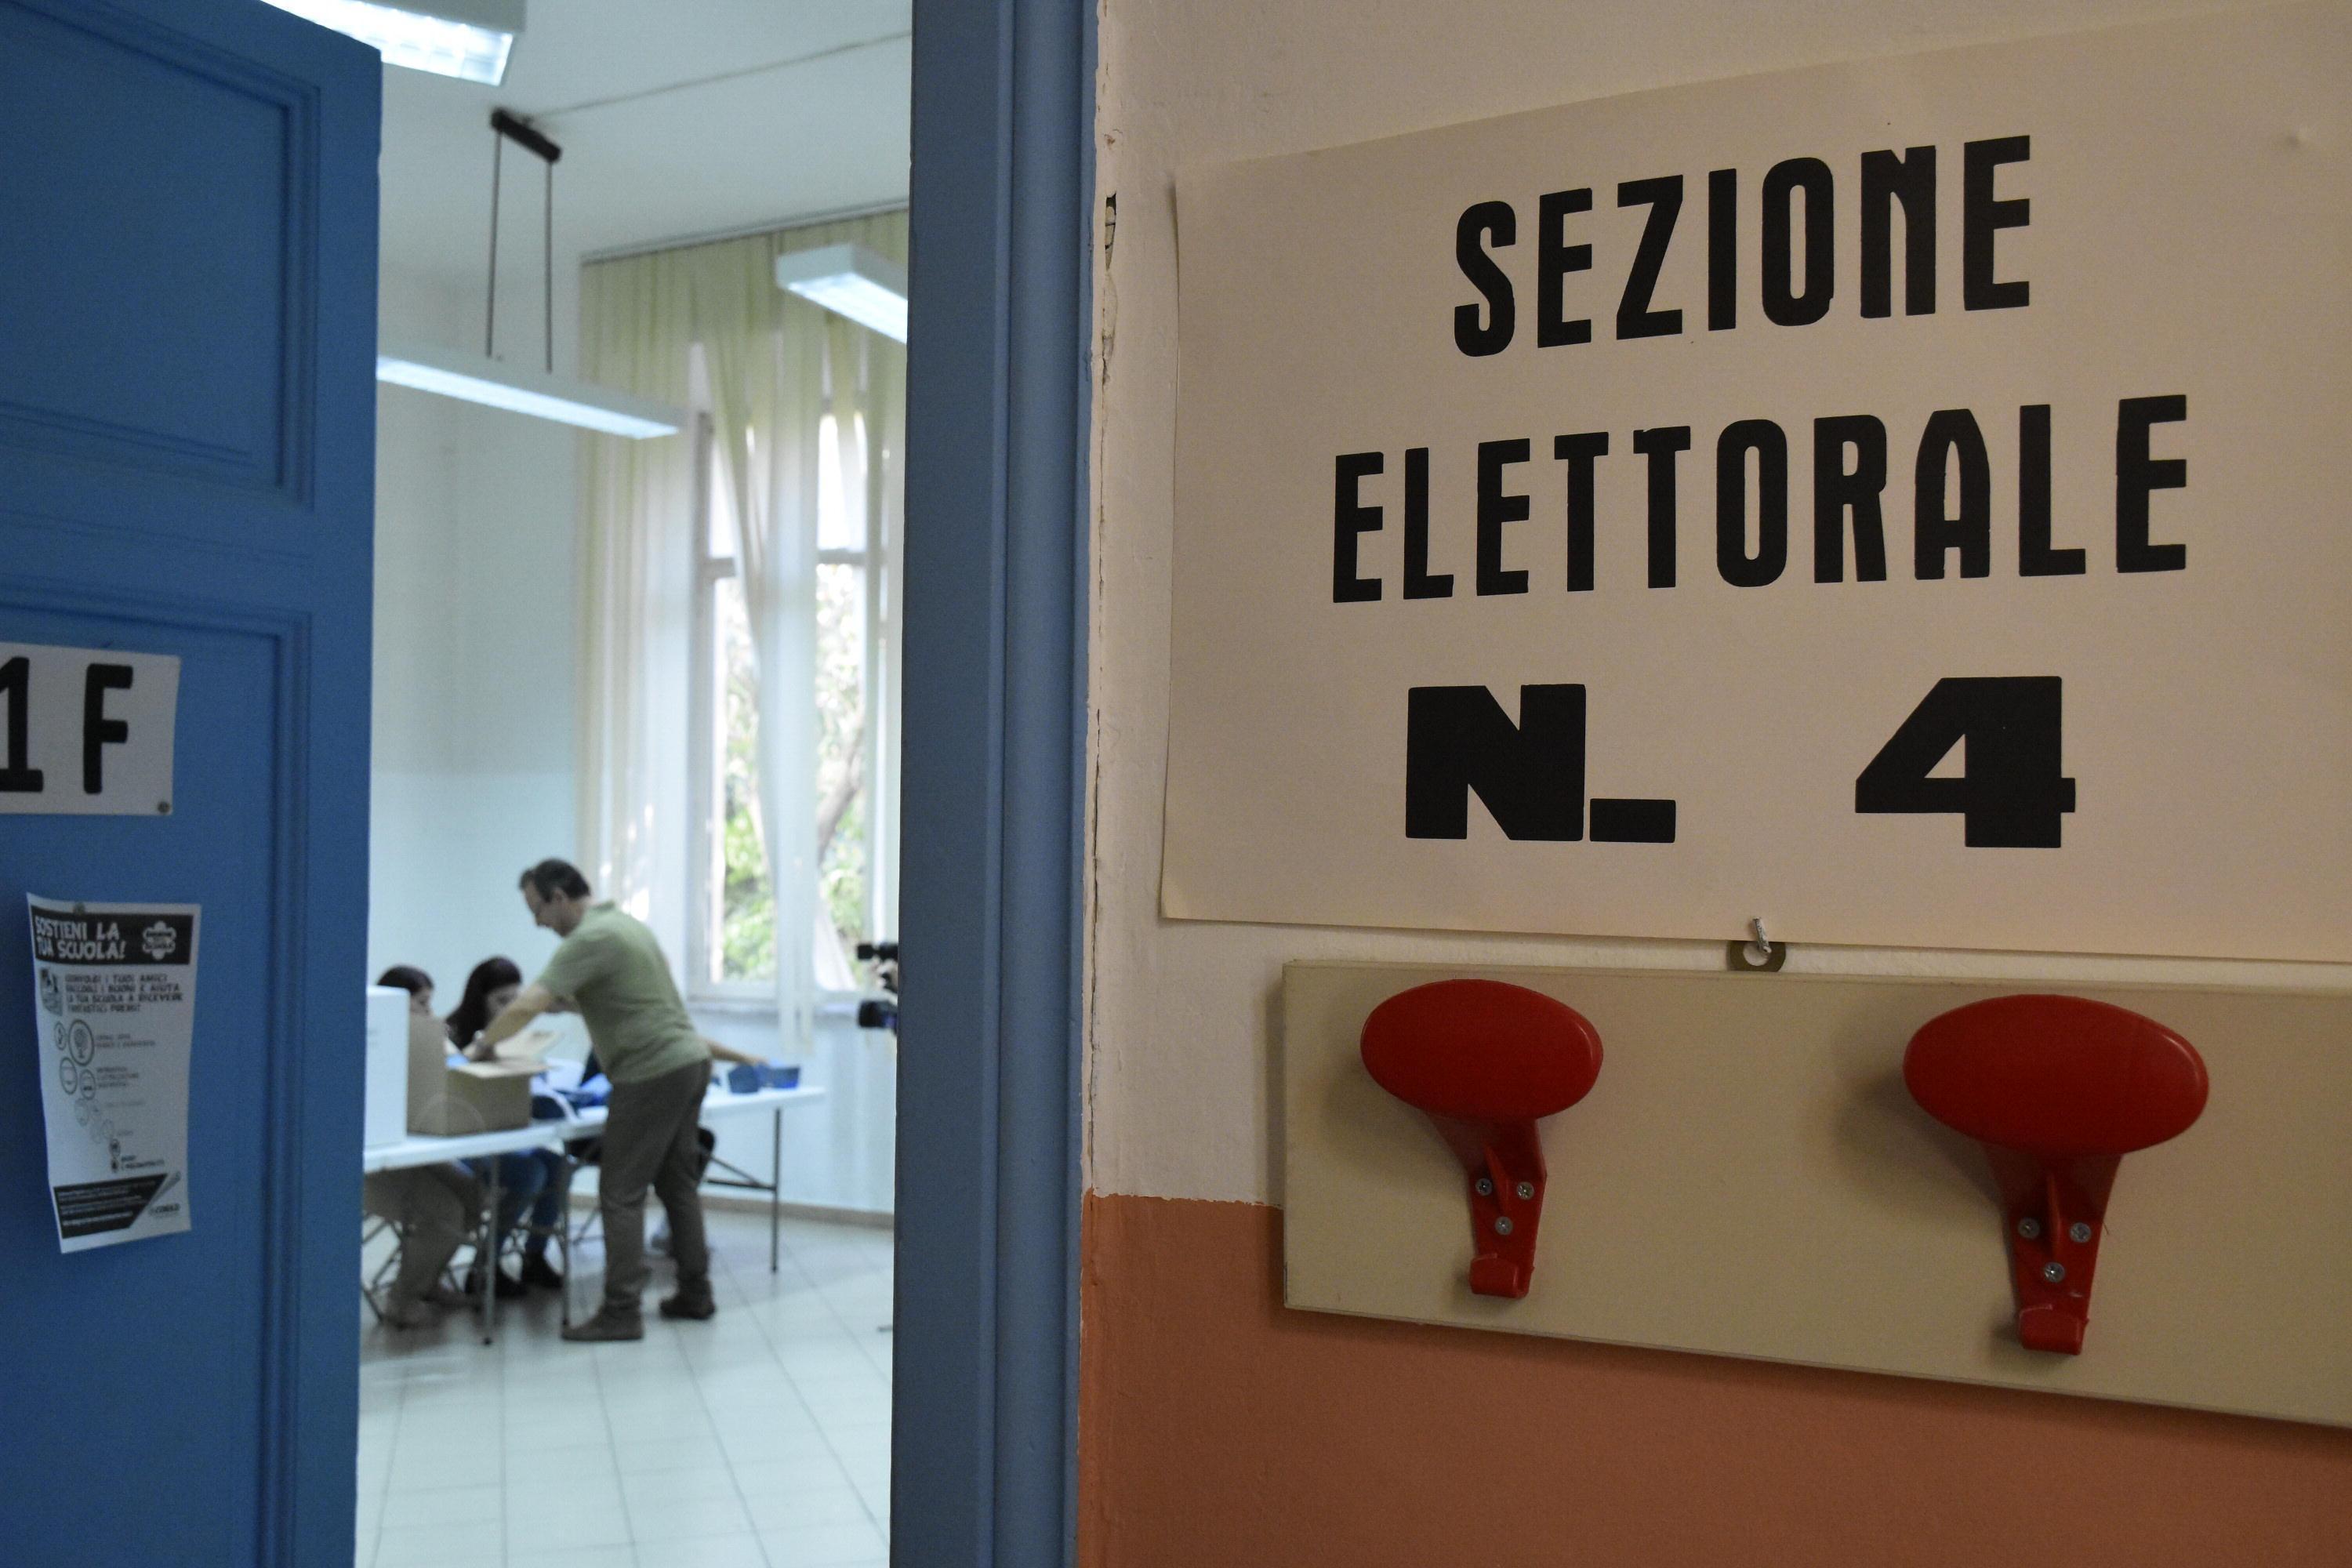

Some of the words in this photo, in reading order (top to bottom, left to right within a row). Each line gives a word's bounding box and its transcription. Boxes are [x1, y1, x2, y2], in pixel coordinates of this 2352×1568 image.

[1454, 136, 2030, 358] SEZIONE
[1333, 395, 2186, 603] ELETTORALE
[1855, 677, 2075, 848] 4
[34, 916, 87, 940] SOSTIENI
[96, 922, 119, 940] LA
[57, 940, 126, 960] SCUOLA!
